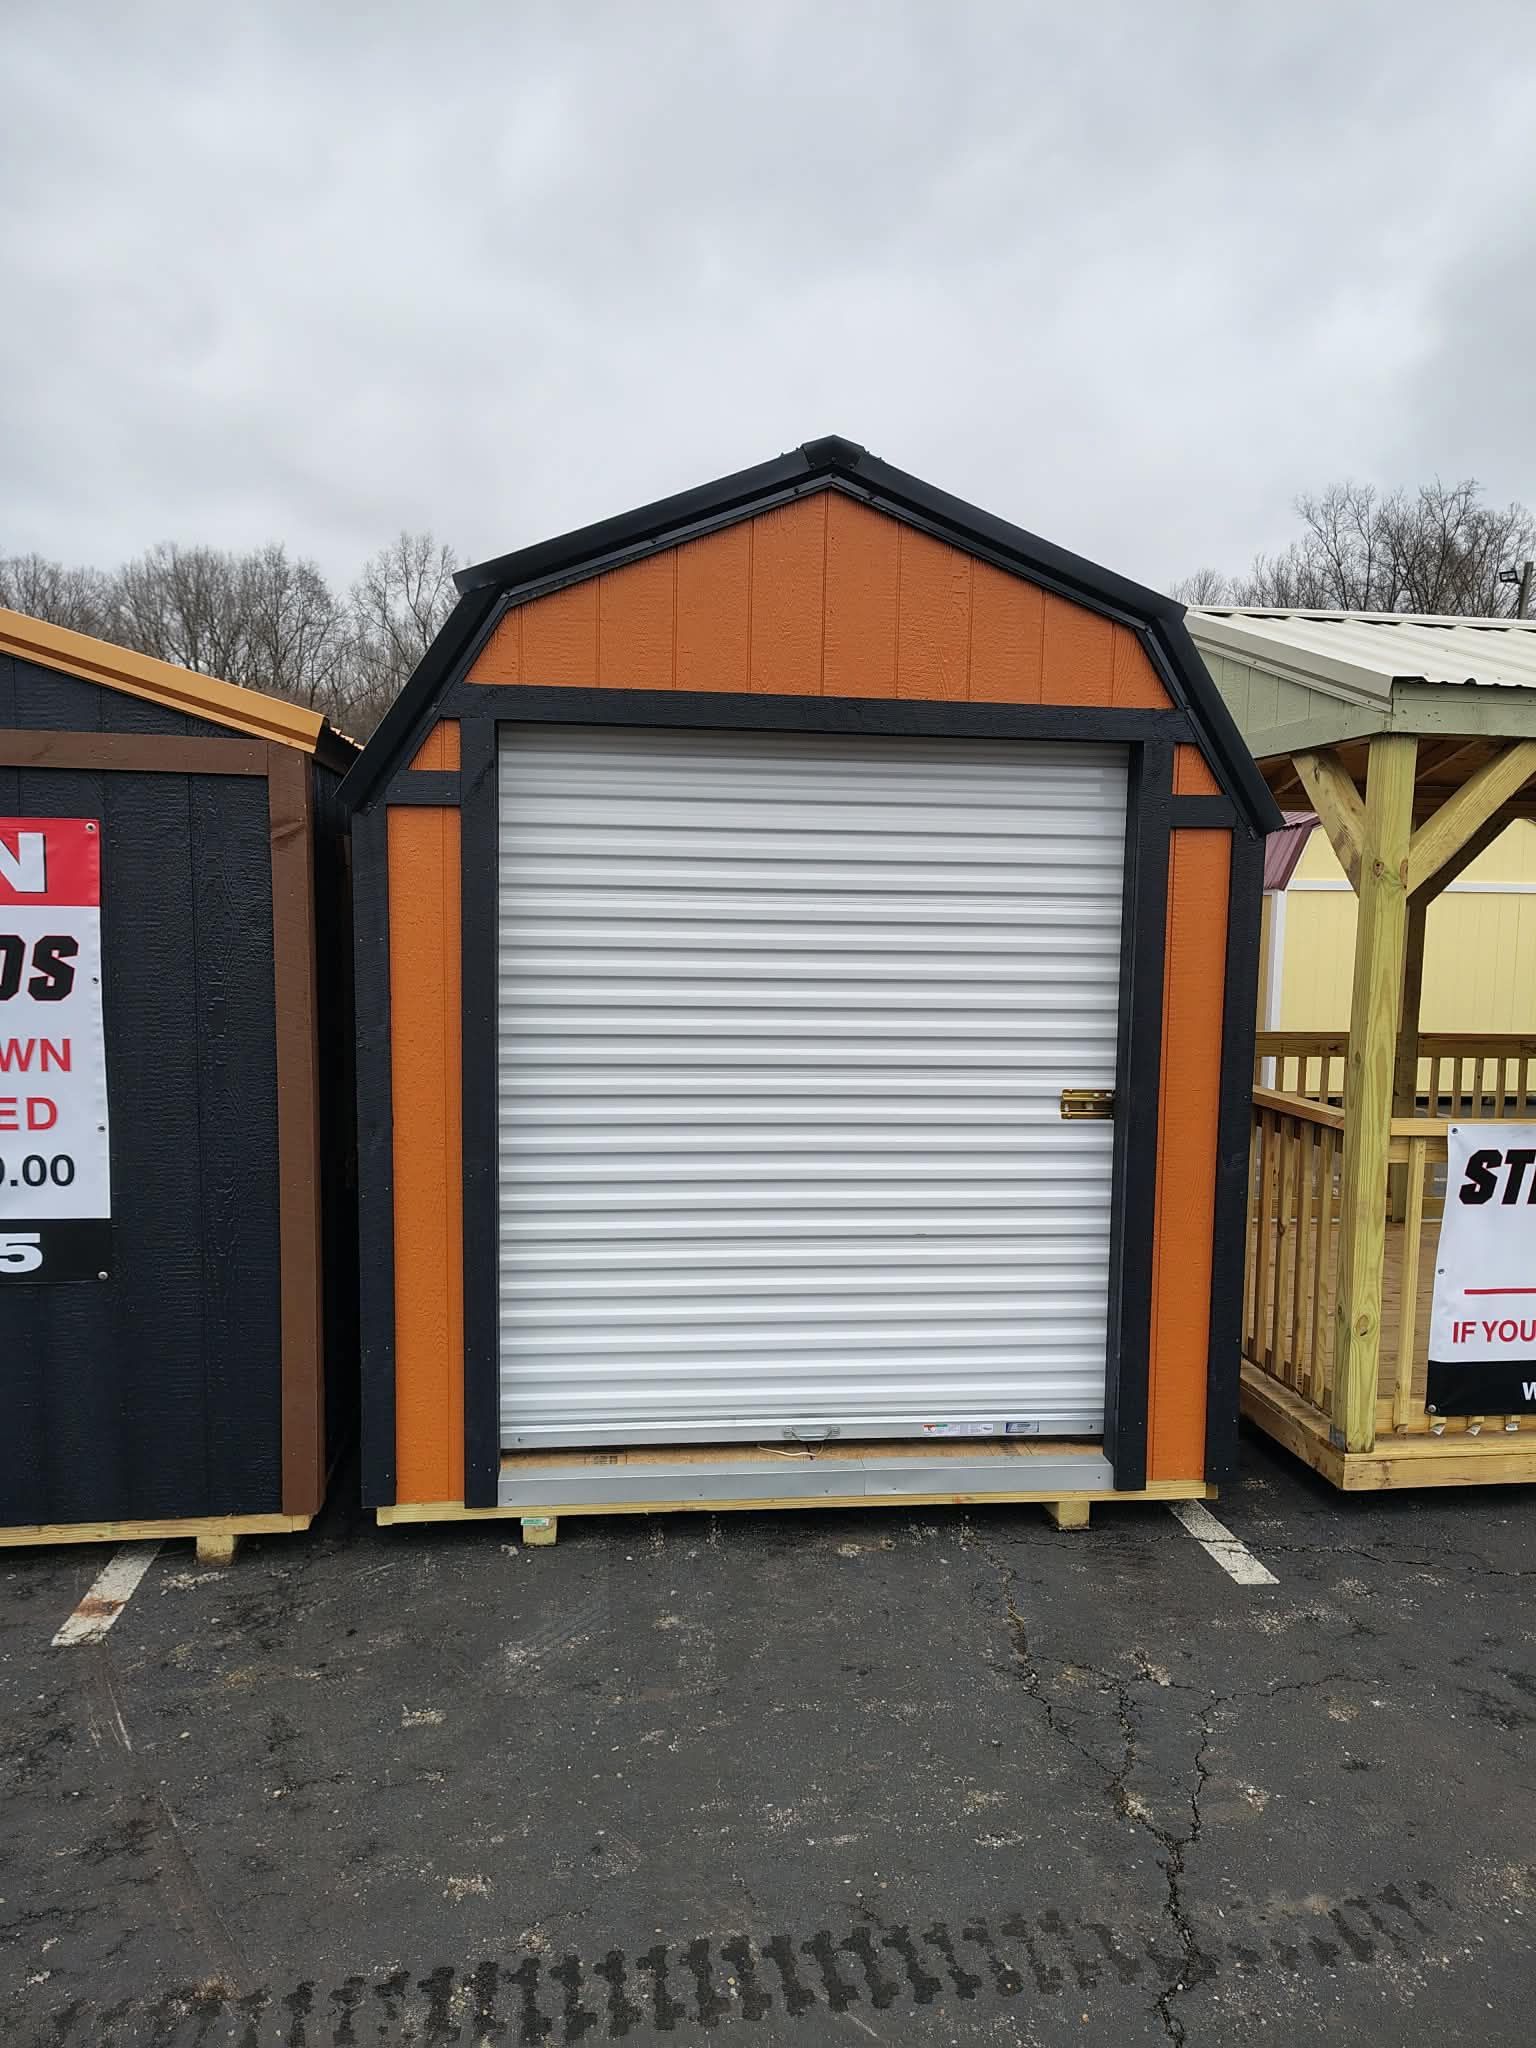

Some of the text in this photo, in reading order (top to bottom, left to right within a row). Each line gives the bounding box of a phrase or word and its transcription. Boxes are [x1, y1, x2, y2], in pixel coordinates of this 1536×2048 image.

[0, 1154, 75, 1187] .00
[1458, 1148, 1536, 1205] ST
[1453, 1319, 1536, 1344] IF YOU
